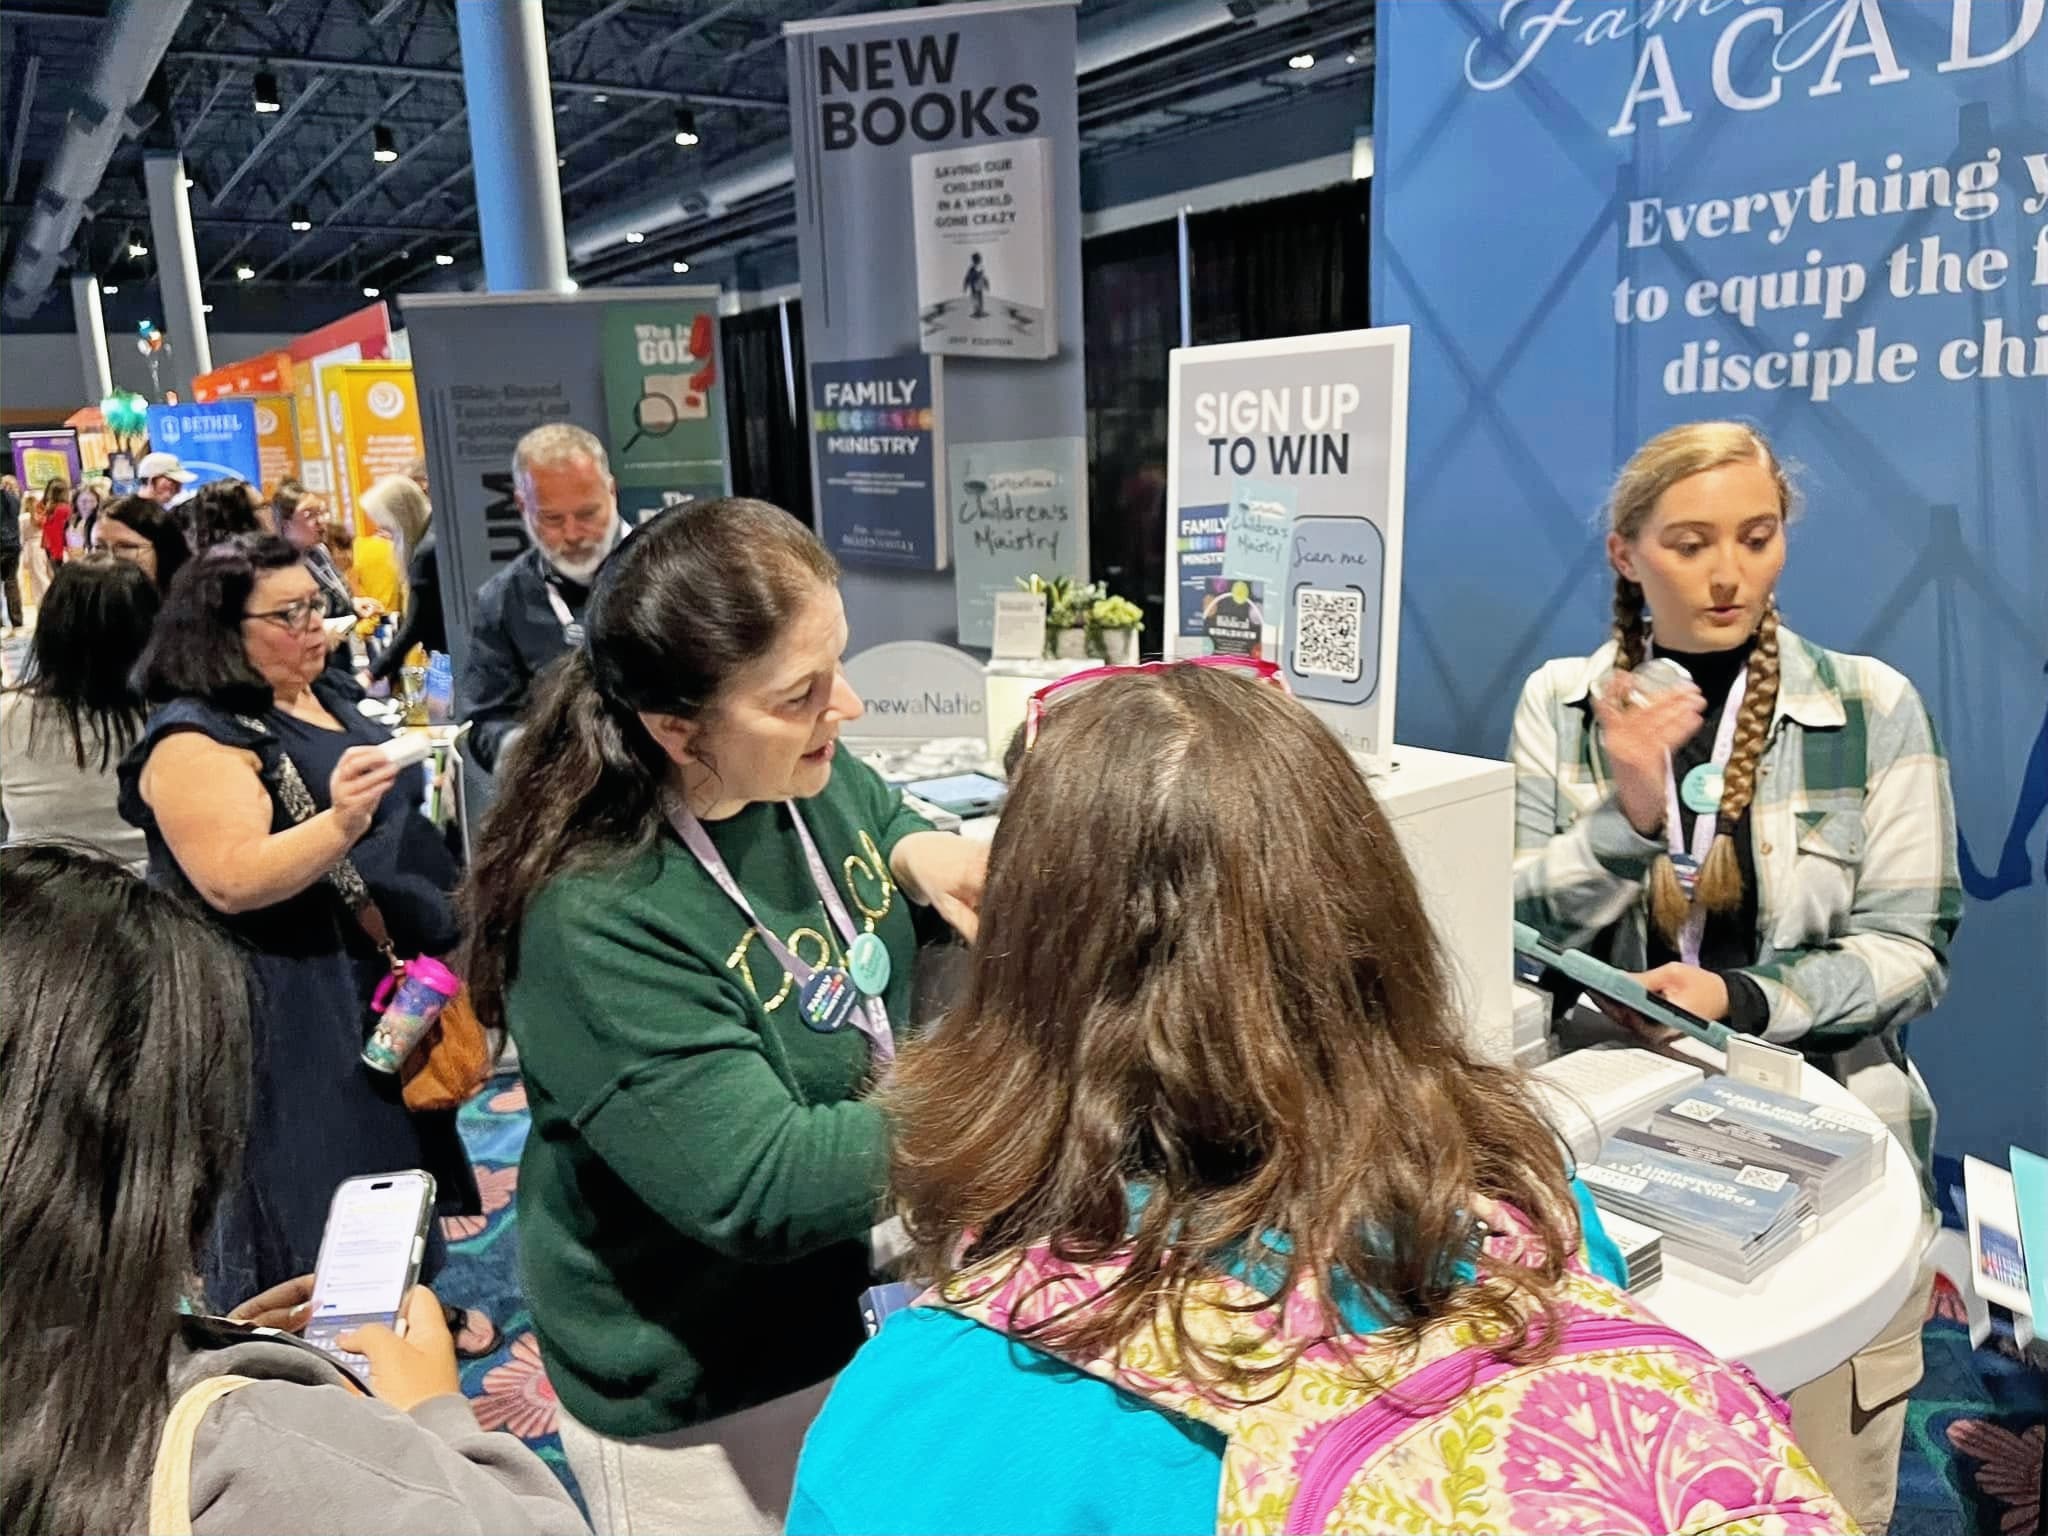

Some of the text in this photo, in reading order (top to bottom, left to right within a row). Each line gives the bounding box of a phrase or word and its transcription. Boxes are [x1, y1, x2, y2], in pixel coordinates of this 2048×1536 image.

[819, 32, 960, 95] NEW
[1608, 0, 2046, 137] ACAD
[823, 84, 1040, 151] BOOKS
[935, 158, 1013, 179] SAVING OUR
[942, 178, 1004, 195] CHILDREN
[965, 194, 1014, 209] WORLD
[1626, 148, 2002, 248] Everything
[934, 211, 1017, 228] GONE CRAZY
[1612, 278, 1669, 326] to
[1684, 249, 1866, 326] equip
[1888, 236, 2009, 299] the
[634, 324, 671, 338] Who
[1663, 320, 2048, 402] disciple chi
[824, 378, 918, 407] FAMILY
[182, 414, 242, 433] BETHEL
[1195, 383, 1360, 436] SIGN UP
[827, 436, 920, 455] MINISTRY
[1208, 433, 1349, 476] TO WIN
[958, 492, 1068, 525] Children's
[1181, 517, 1228, 536] FAMILY
[974, 525, 1059, 563] Ministry
[1293, 536, 1367, 568] Scan me
